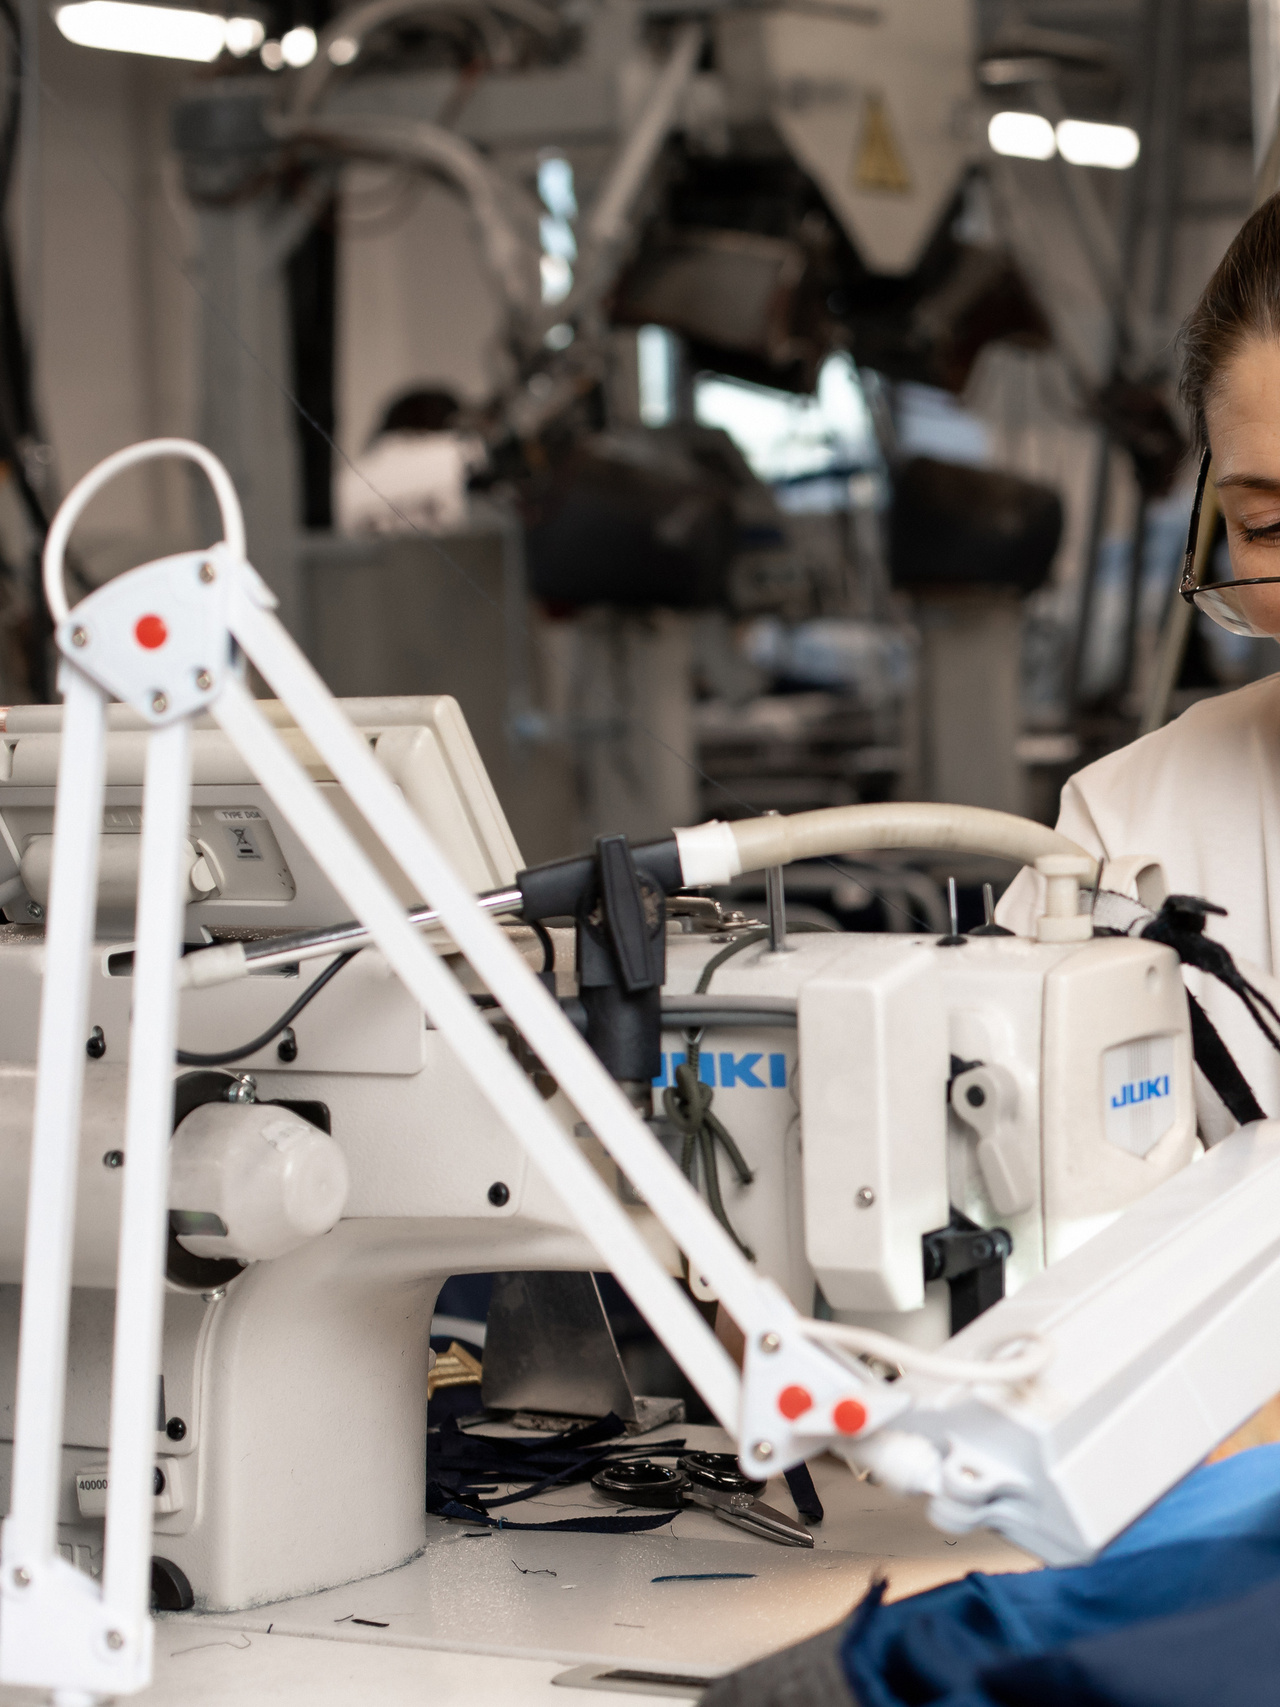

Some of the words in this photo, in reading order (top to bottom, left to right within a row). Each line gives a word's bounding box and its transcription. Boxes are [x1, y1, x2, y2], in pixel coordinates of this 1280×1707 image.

[222, 811, 243, 819] TYPE
[1111, 1074, 1169, 1108] JUKI
[79, 1479, 108, 1490] 40000
